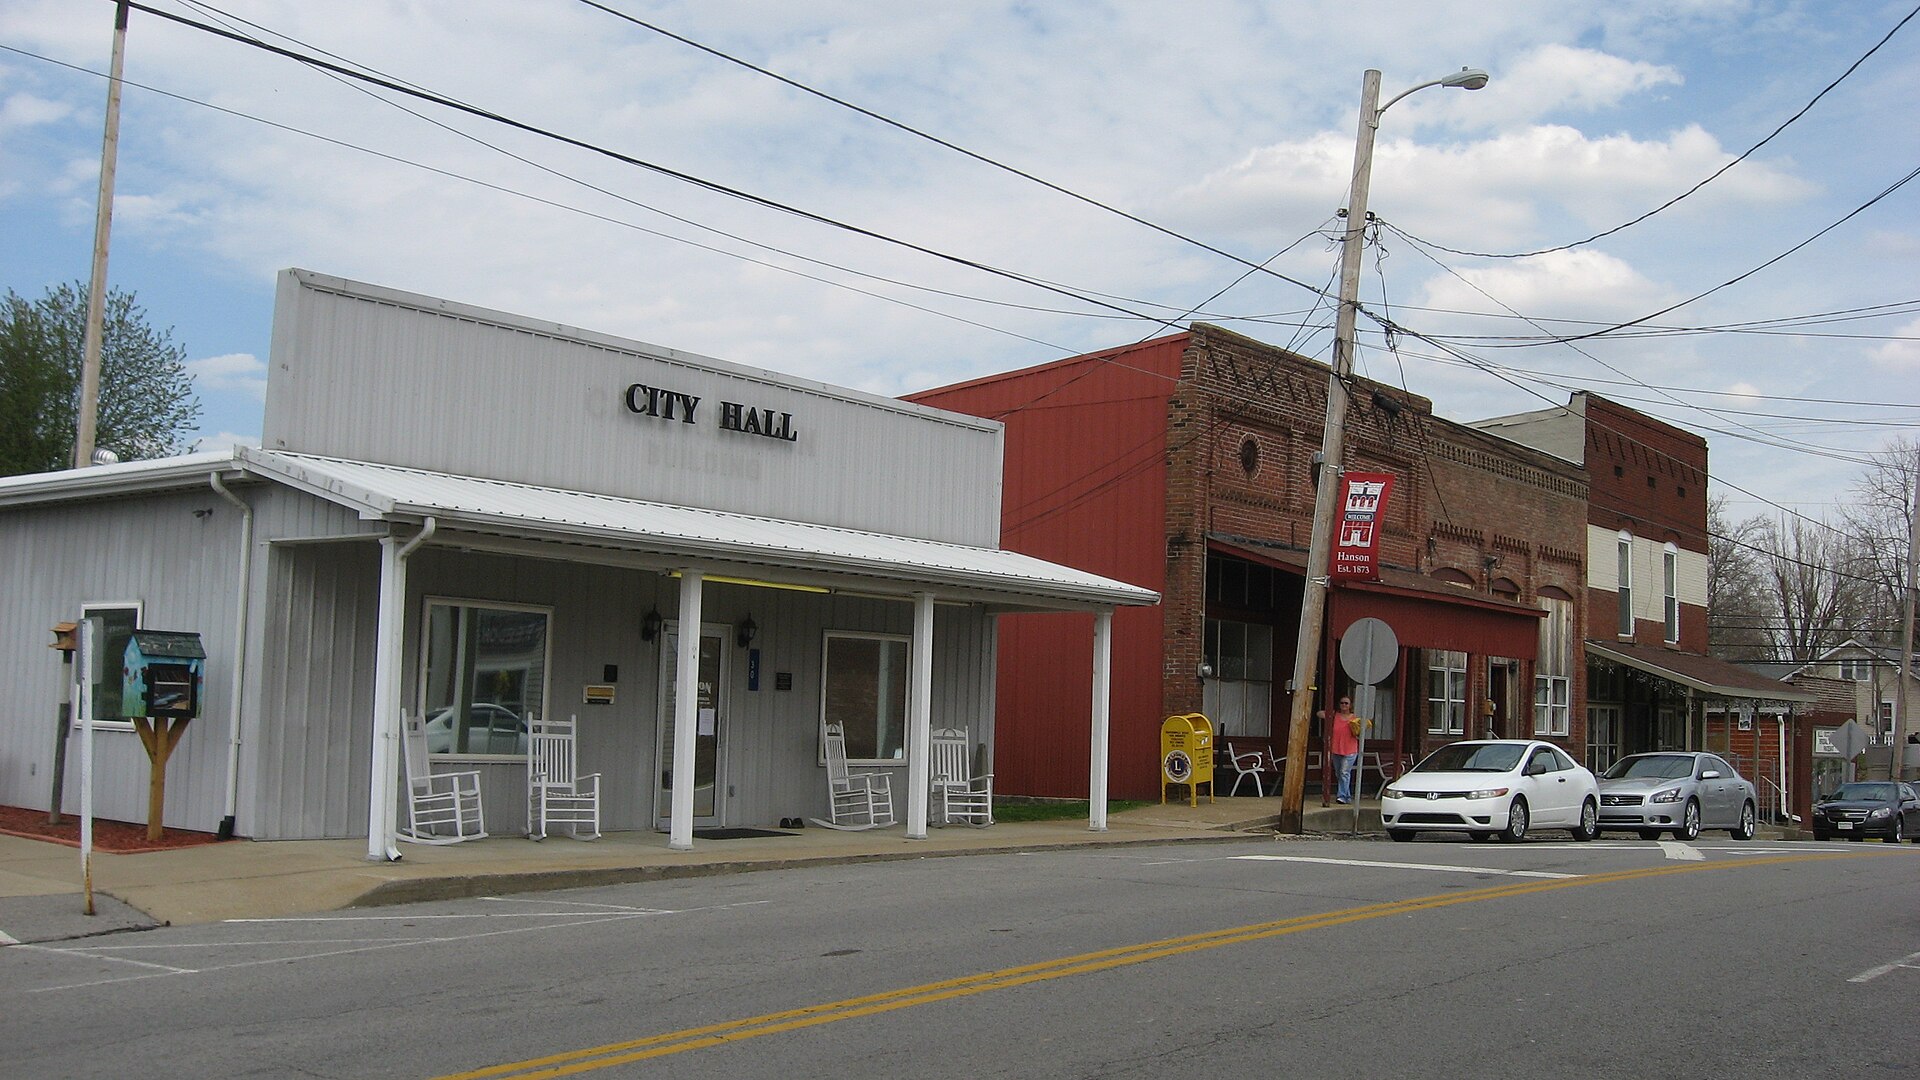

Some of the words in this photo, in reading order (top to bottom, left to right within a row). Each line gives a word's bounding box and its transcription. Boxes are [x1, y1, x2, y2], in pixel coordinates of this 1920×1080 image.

[625, 383, 702, 425] CITY
[718, 401, 798, 442] HALL
[1337, 551, 1370, 562] Hanson
[1337, 565, 1352, 573] Est.
[1353, 565, 1370, 574] 1873
